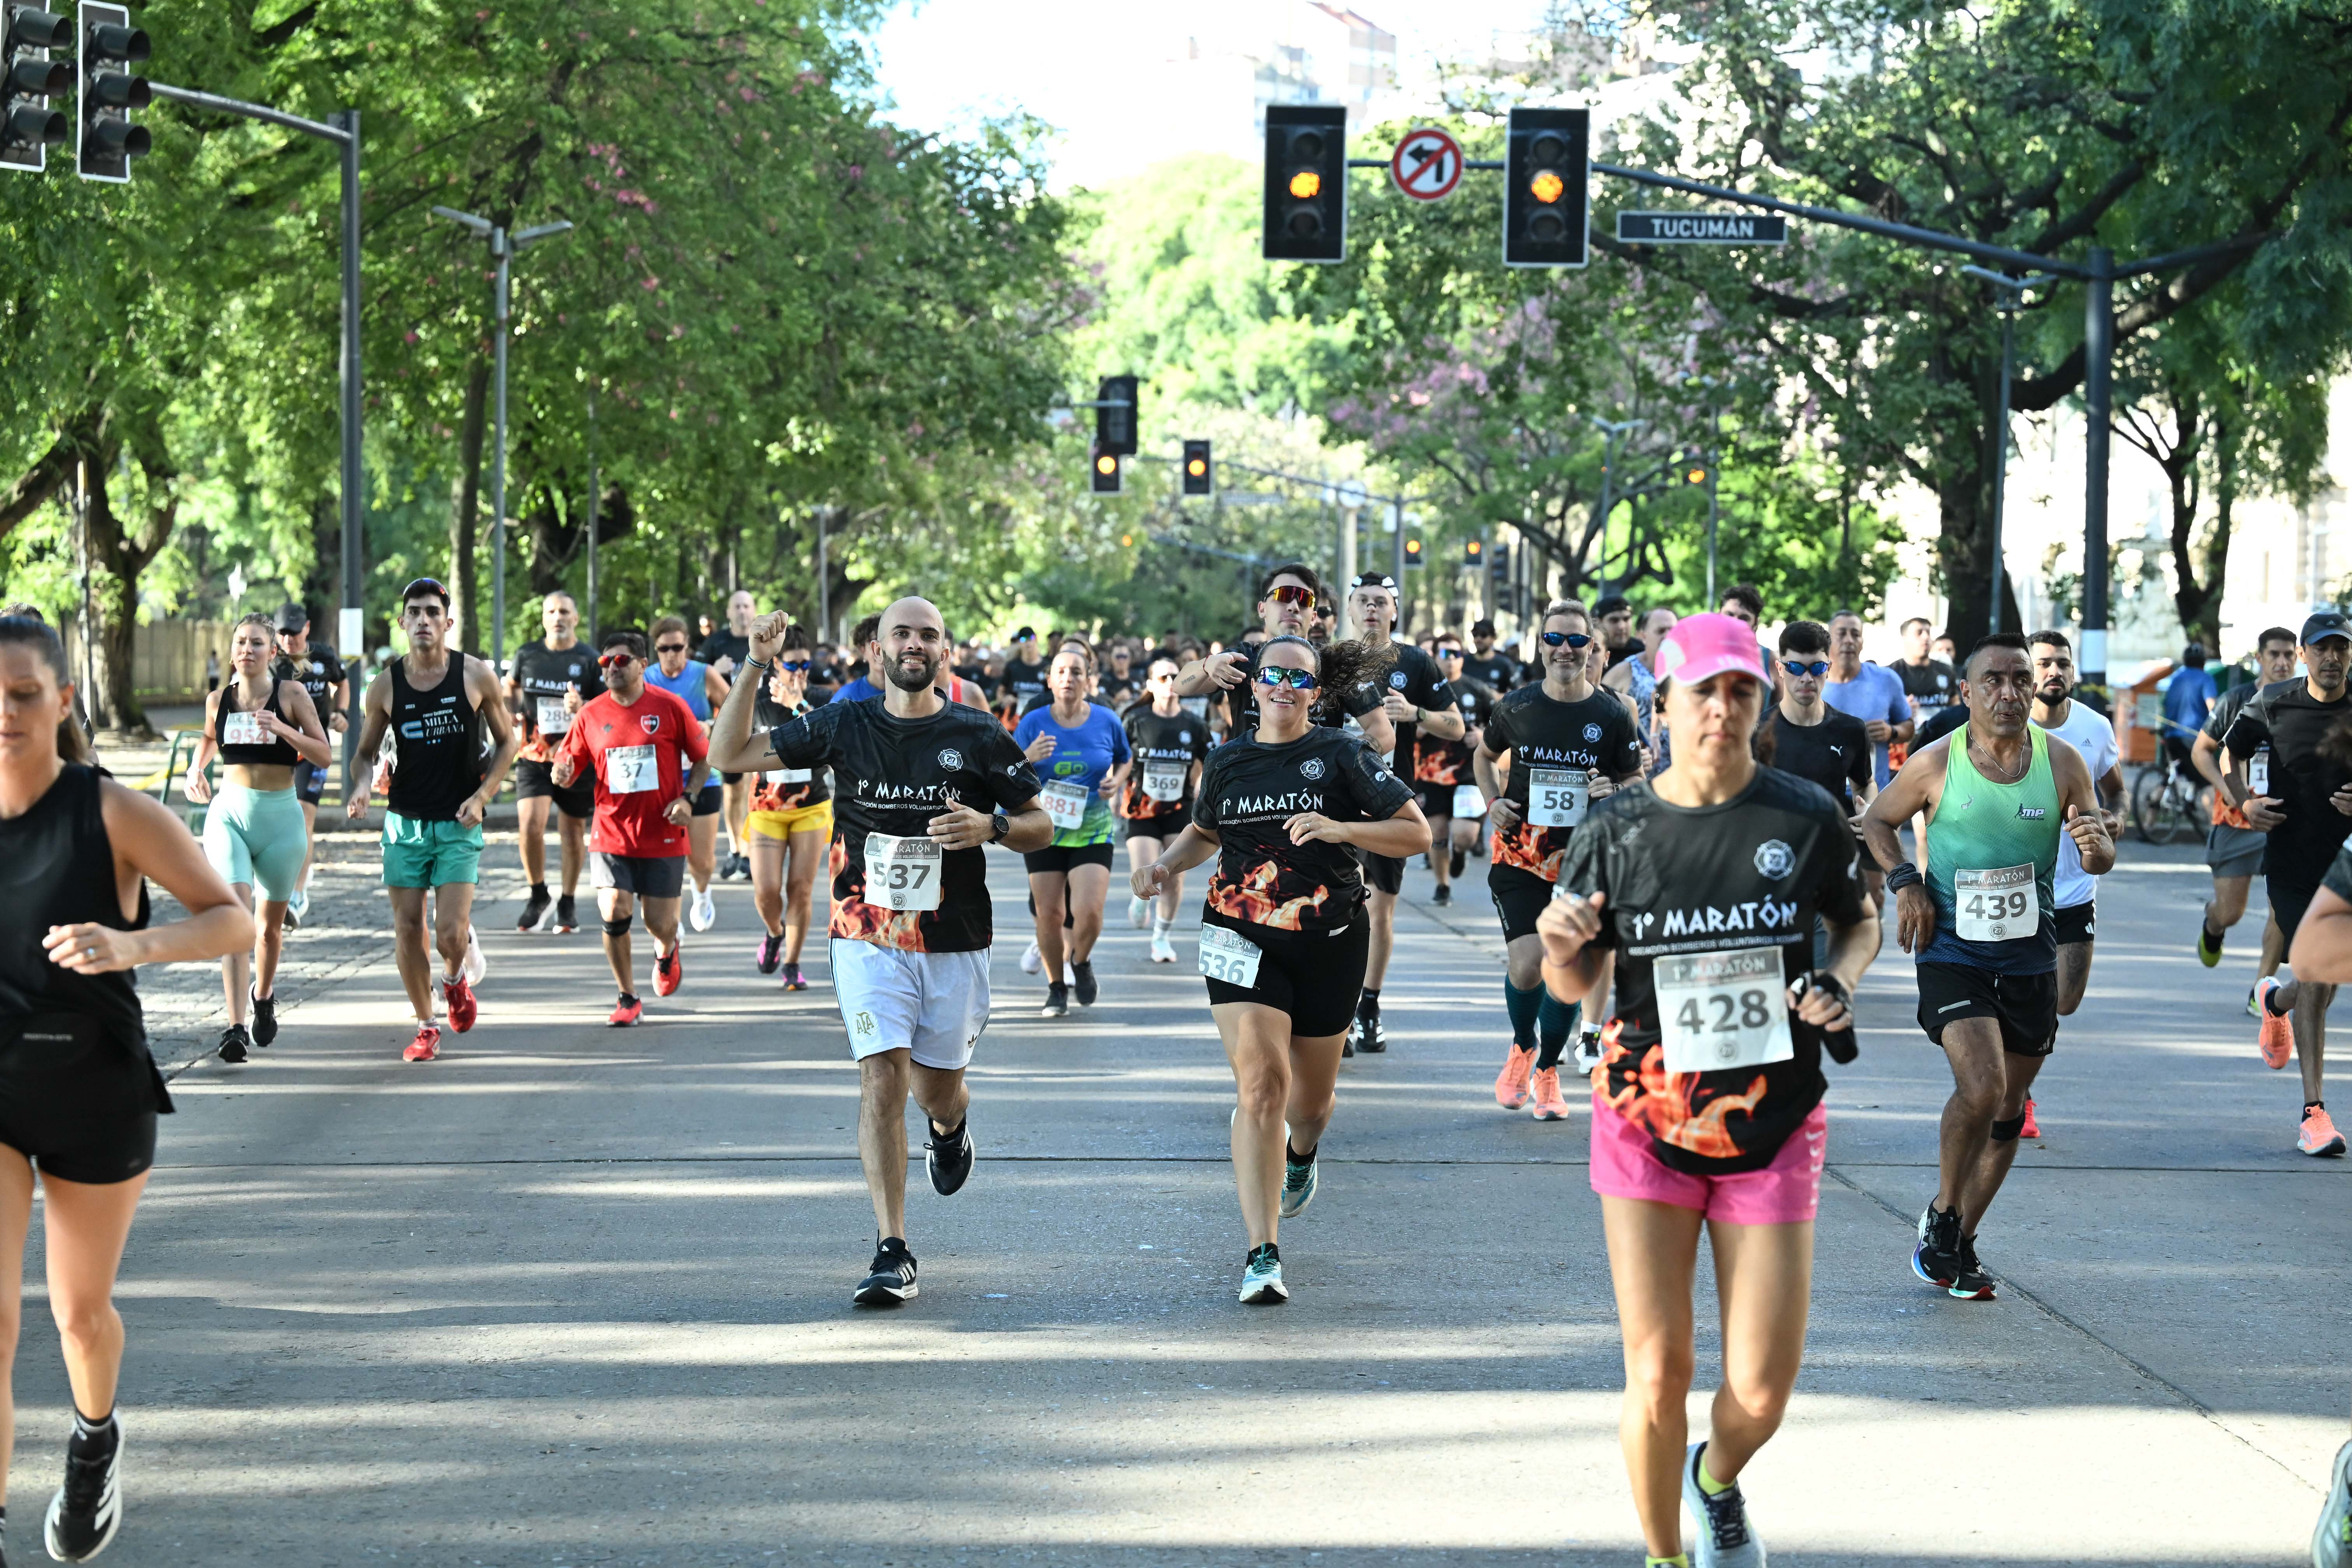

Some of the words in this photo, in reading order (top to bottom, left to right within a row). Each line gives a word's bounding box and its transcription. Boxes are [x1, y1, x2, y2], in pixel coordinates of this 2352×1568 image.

[1651, 215, 1755, 238] TUCUMÁN
[425, 714, 458, 727] MILLA
[426, 724, 464, 737] URBANA
[230, 728, 269, 744] 954
[1533, 746, 1598, 766] MARATÓN
[621, 763, 643, 778] 37
[1547, 774, 1583, 783] MARATÓN
[875, 780, 961, 802] MARATÓN
[1149, 777, 1178, 790] 369
[1044, 796, 1076, 816] 881
[1237, 788, 1323, 814] MARATÓN
[1544, 790, 1575, 810] 58
[1242, 815, 1271, 824] BOMBEROS
[887, 842, 930, 853] ARATÓN
[873, 862, 931, 889] 537
[1978, 869, 2025, 885] MARATÓN
[1662, 893, 1797, 938] MARATÓN
[1965, 891, 2027, 920] 439
[1212, 933, 1252, 950] MARATÓN
[1199, 950, 1246, 985] 536
[1690, 953, 1766, 979] MARATÓN
[1676, 989, 1770, 1035] 428
